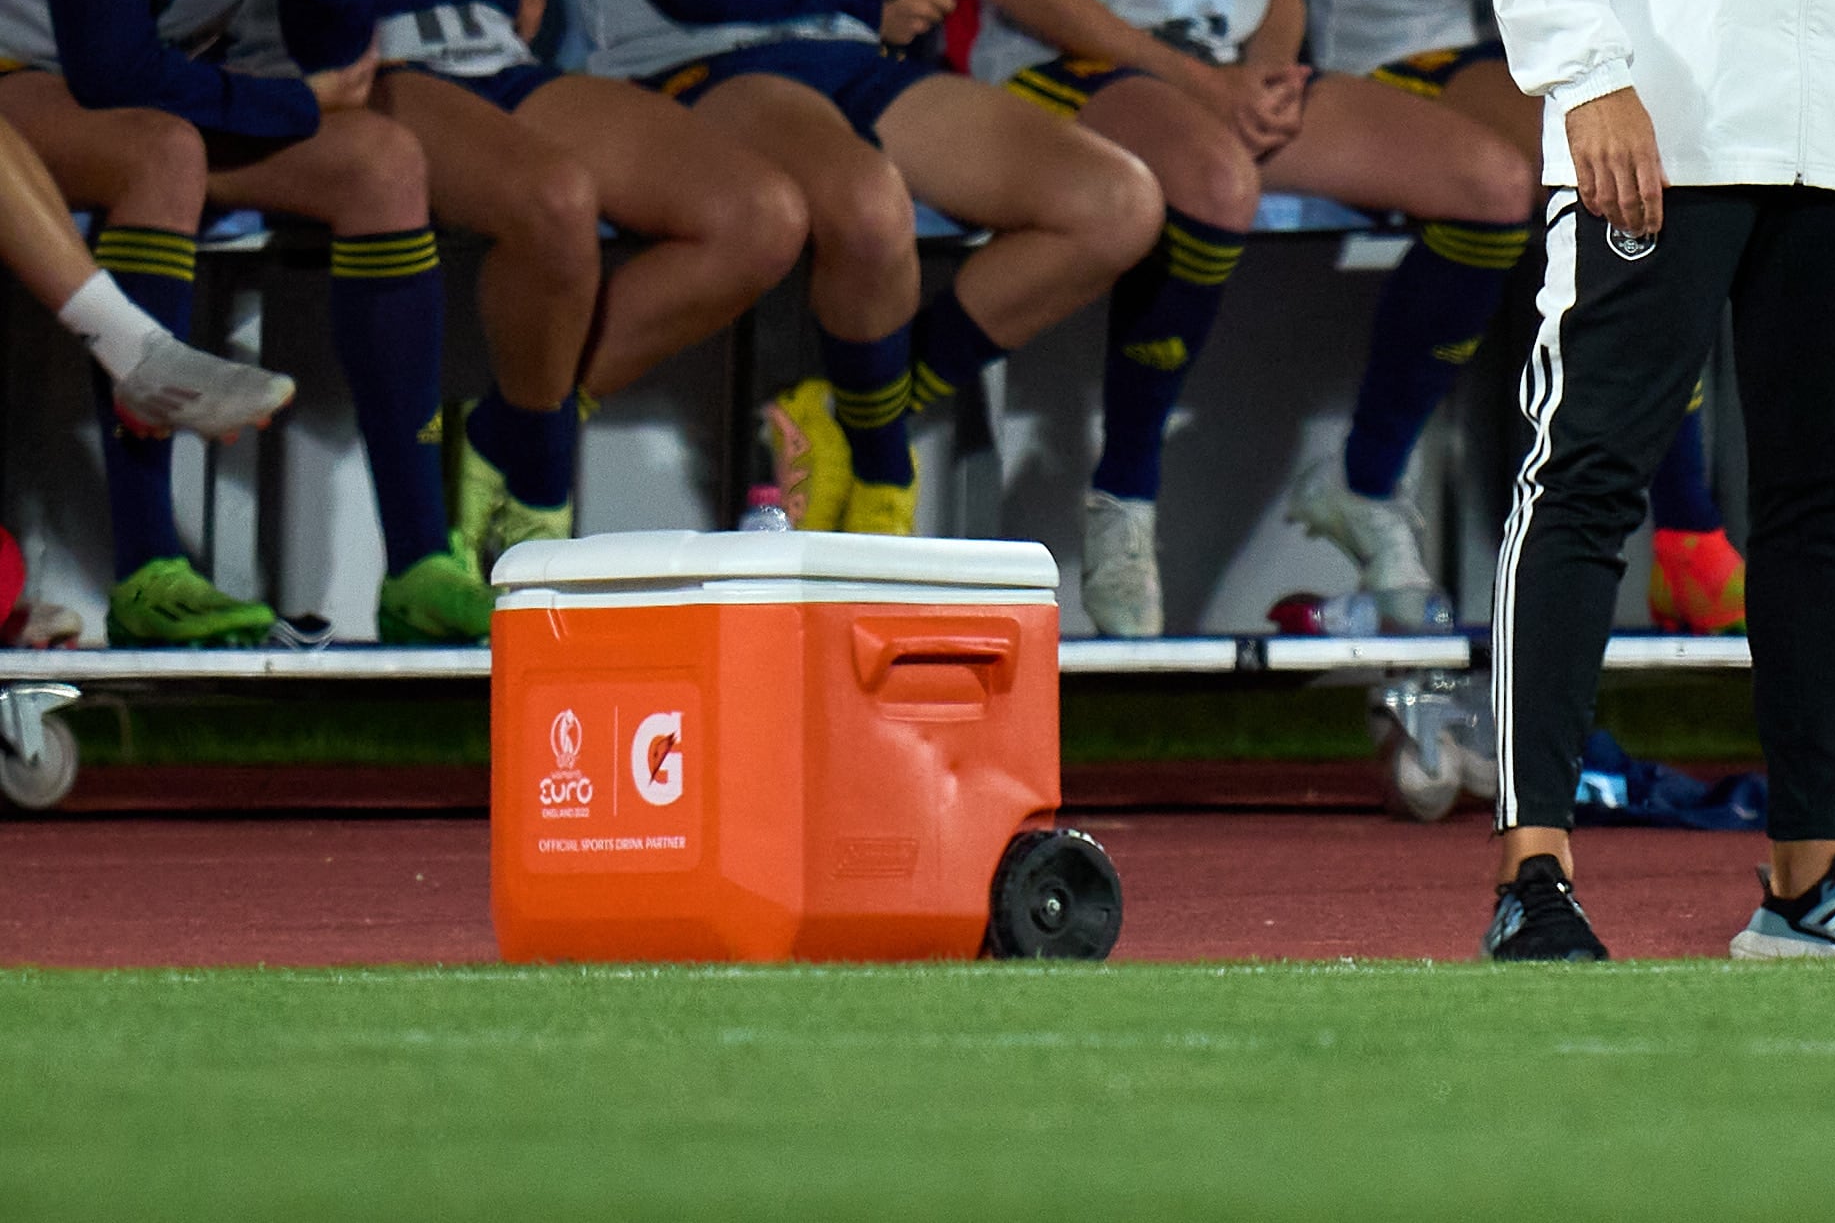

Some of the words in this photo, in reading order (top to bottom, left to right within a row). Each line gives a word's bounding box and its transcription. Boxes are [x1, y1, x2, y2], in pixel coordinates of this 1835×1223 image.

[538, 838, 578, 853] OFFICIAL
[580, 837, 615, 851] SPORTS
[615, 837, 644, 850] DRINK
[645, 835, 686, 849] PARTNER
